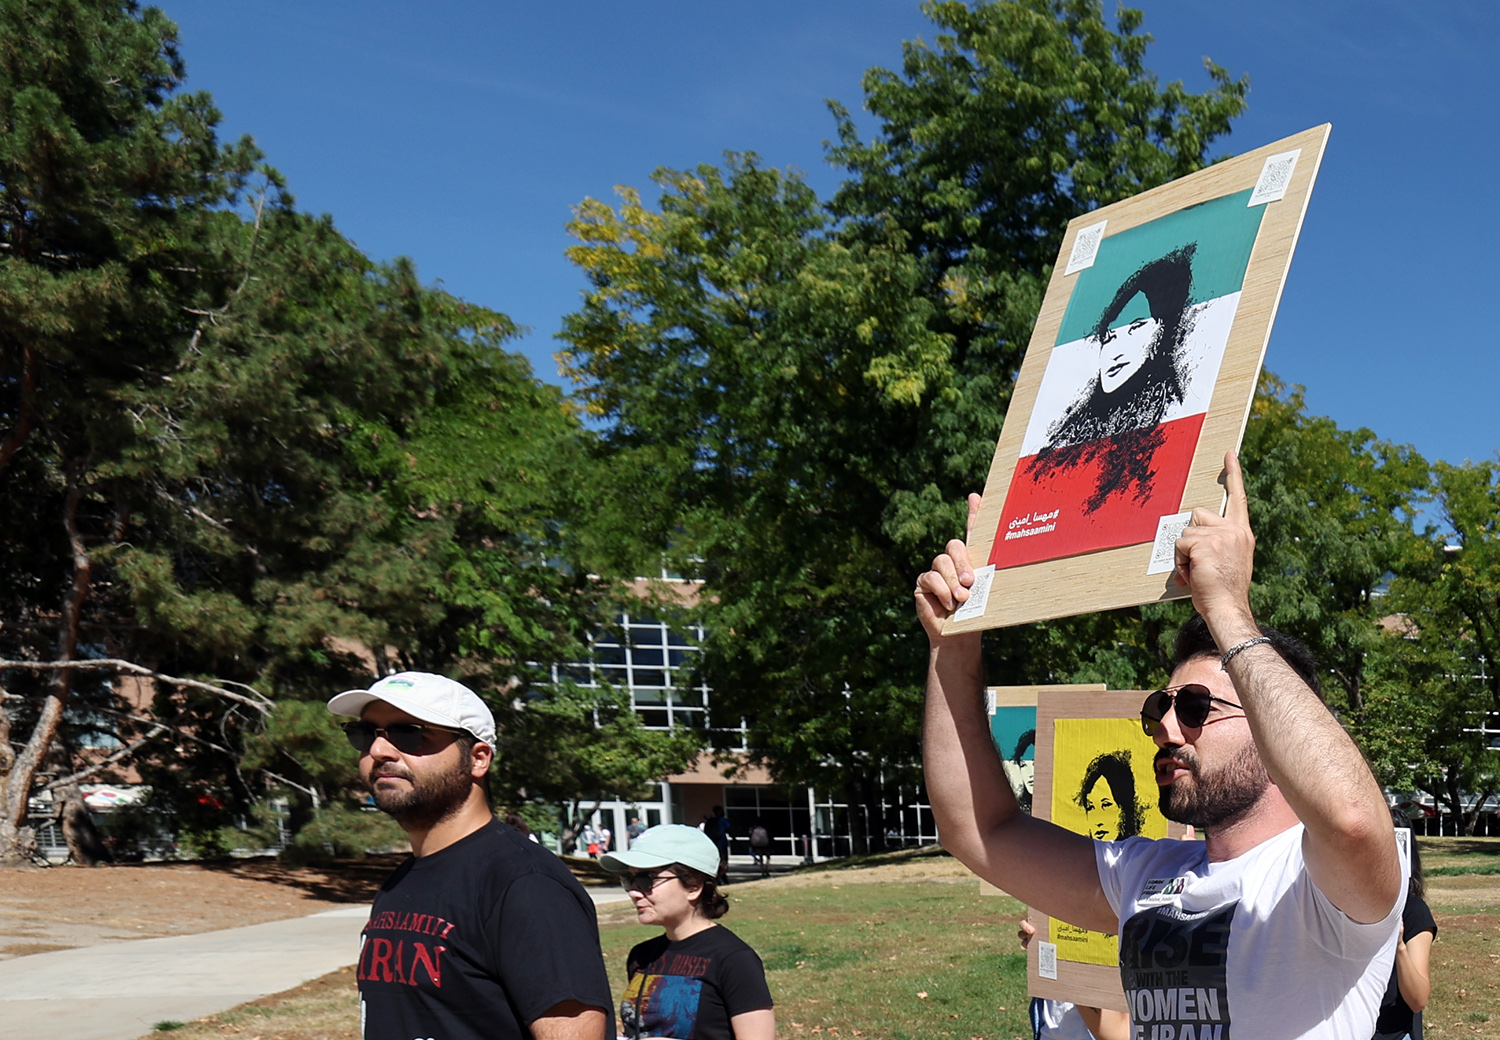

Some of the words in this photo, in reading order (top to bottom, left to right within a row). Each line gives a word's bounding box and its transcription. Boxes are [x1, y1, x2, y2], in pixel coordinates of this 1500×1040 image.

[1004, 522, 1056, 541] #mahsaamini
[1136, 971, 1163, 987] WITH
[1166, 970, 1188, 986] THE
